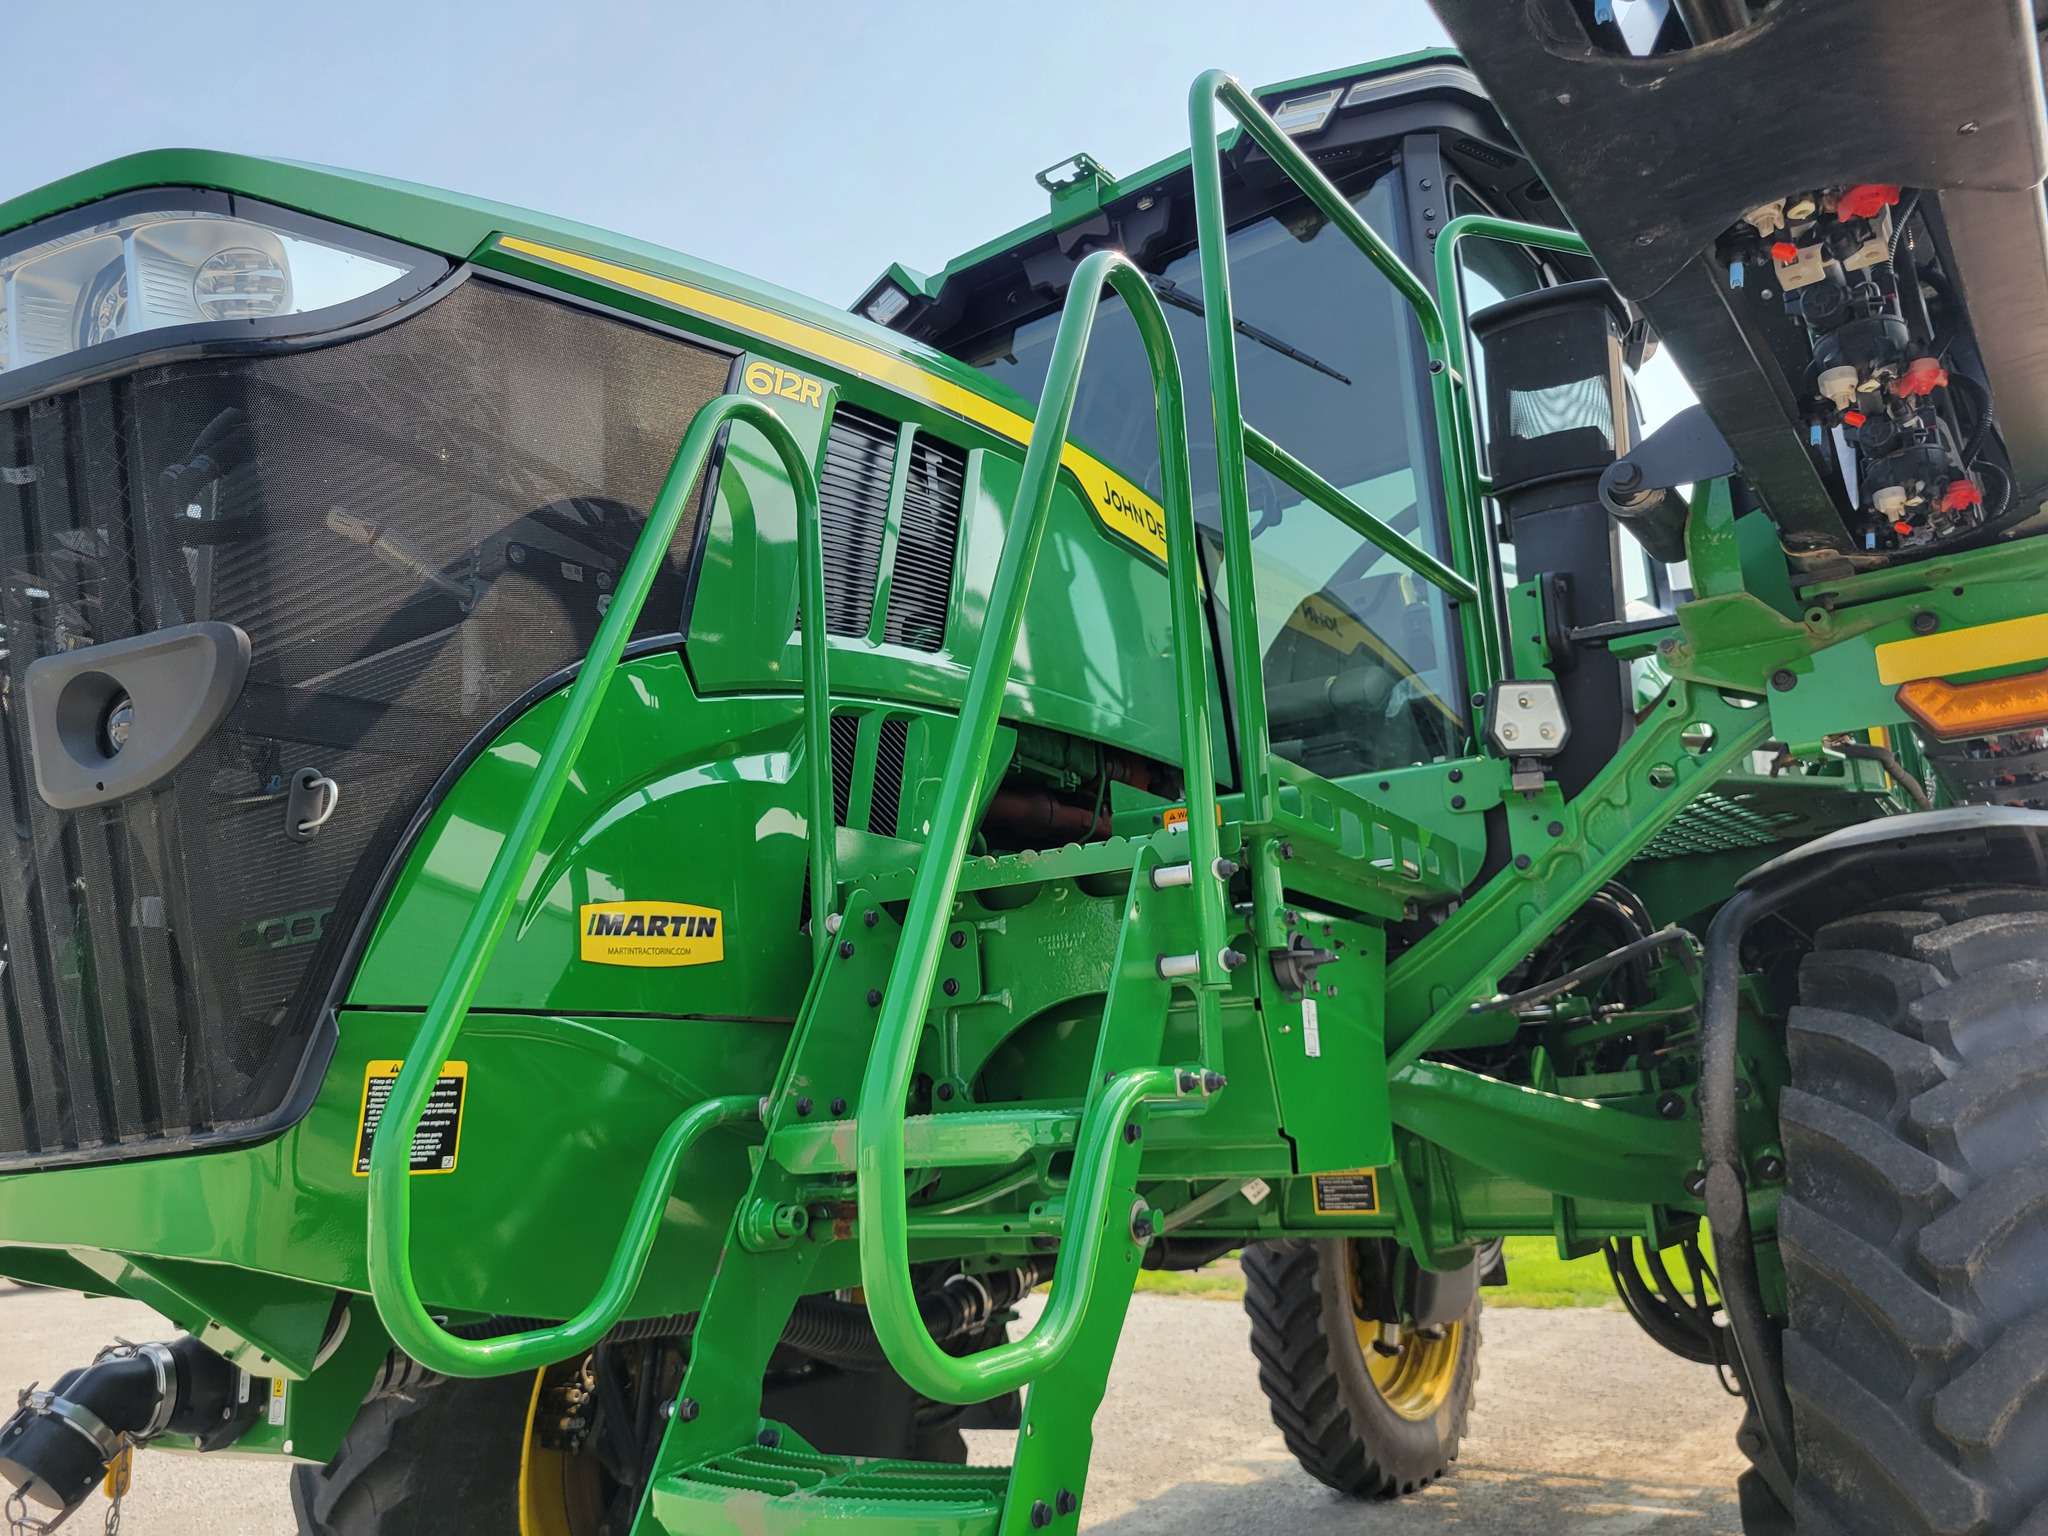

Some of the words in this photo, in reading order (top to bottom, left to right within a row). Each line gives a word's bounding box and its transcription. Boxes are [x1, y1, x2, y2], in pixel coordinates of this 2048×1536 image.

[745, 361, 823, 408] 612R
[1103, 481, 1145, 528] JOHN
[1144, 508, 1167, 544] DE
[594, 914, 718, 938] MARTIN
[608, 947, 692, 956] MARTINTRACTORINC.COM
